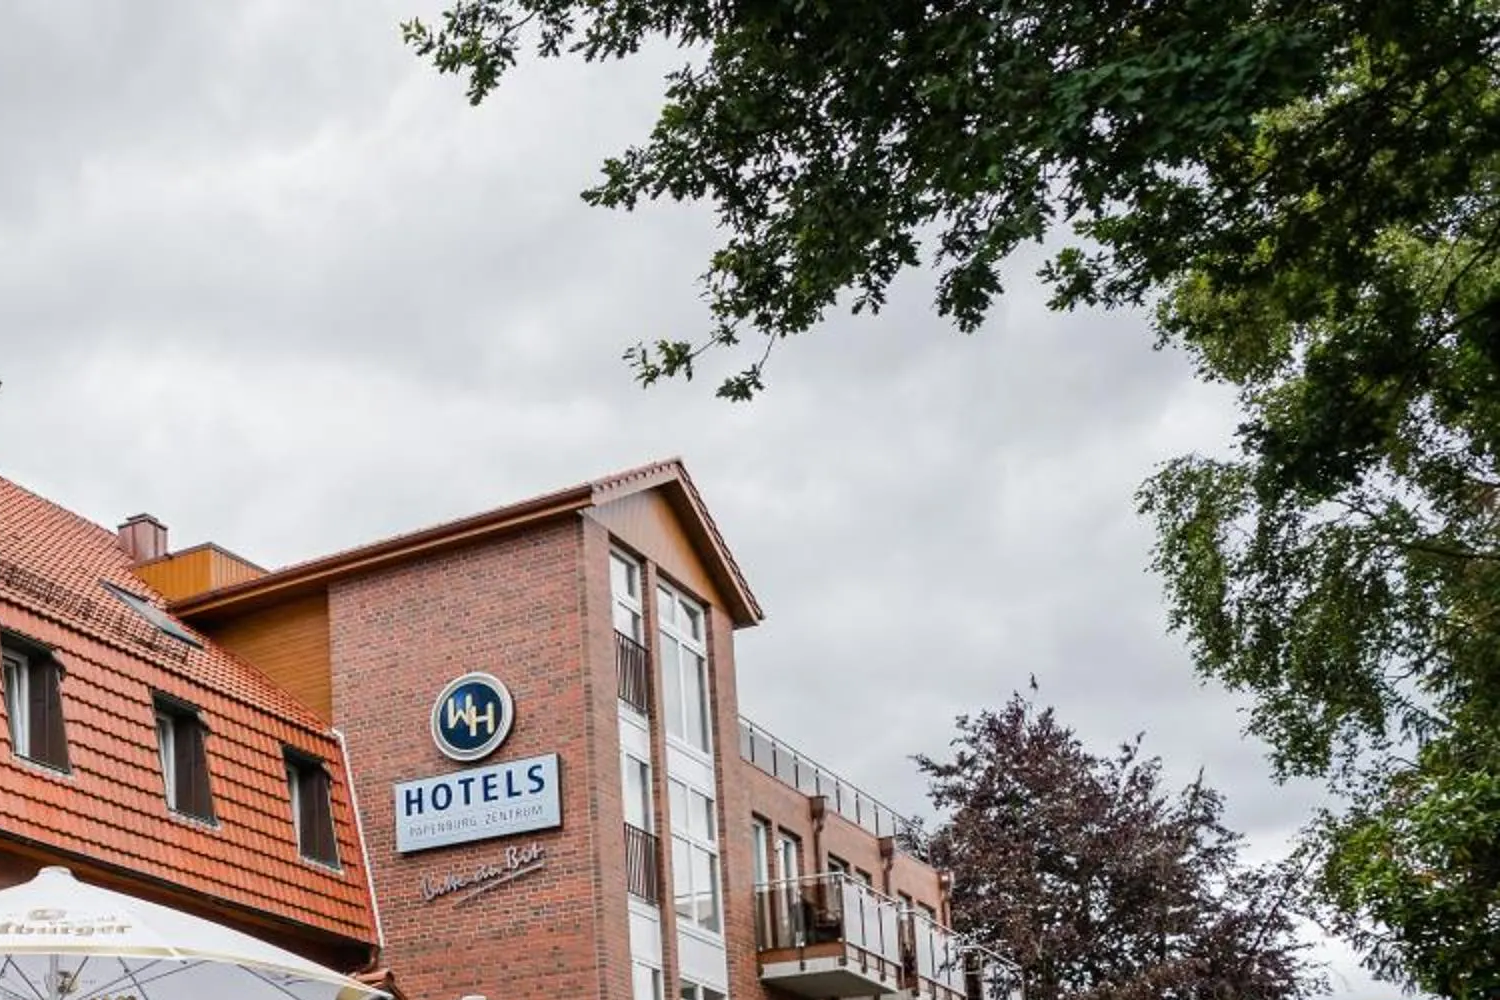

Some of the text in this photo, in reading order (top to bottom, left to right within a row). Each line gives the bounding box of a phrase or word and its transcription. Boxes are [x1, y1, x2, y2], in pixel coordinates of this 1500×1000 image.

[405, 764, 545, 816] HOTELS
[409, 805, 543, 837] PAPENBURG ZENTRUM
